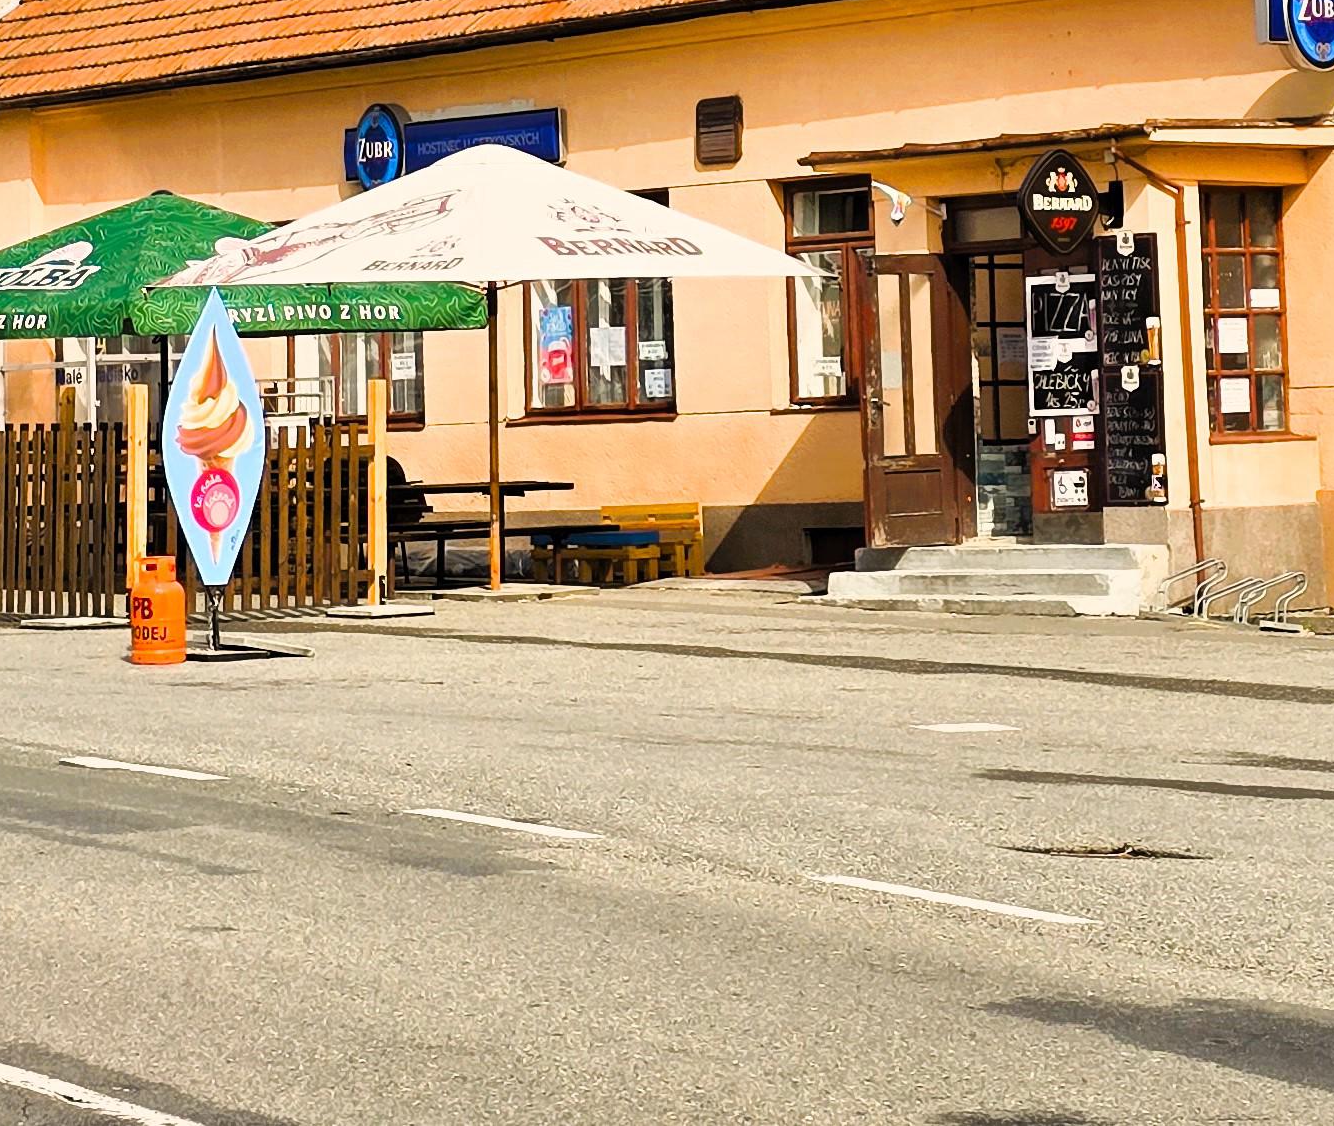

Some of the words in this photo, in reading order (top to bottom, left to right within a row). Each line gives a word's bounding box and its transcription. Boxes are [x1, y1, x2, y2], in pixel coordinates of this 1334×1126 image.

[357, 137, 393, 163] ZUBR
[417, 138, 461, 156] HOSTINEC
[1032, 194, 1093, 212] BERNARD
[535, 236, 703, 256] BERNARD
[363, 257, 464, 271] BERNARD
[227, 303, 276, 323] RYZÍ
[284, 304, 333, 320] PIVO
[340, 304, 351, 320] Z
[359, 304, 402, 320] HOR
[1032, 292, 1091, 332] PIZZA
[12, 314, 48, 330] HOR
[56, 368, 83, 385] alé
[133, 597, 153, 620] PB
[133, 625, 167, 641] ODEJ
